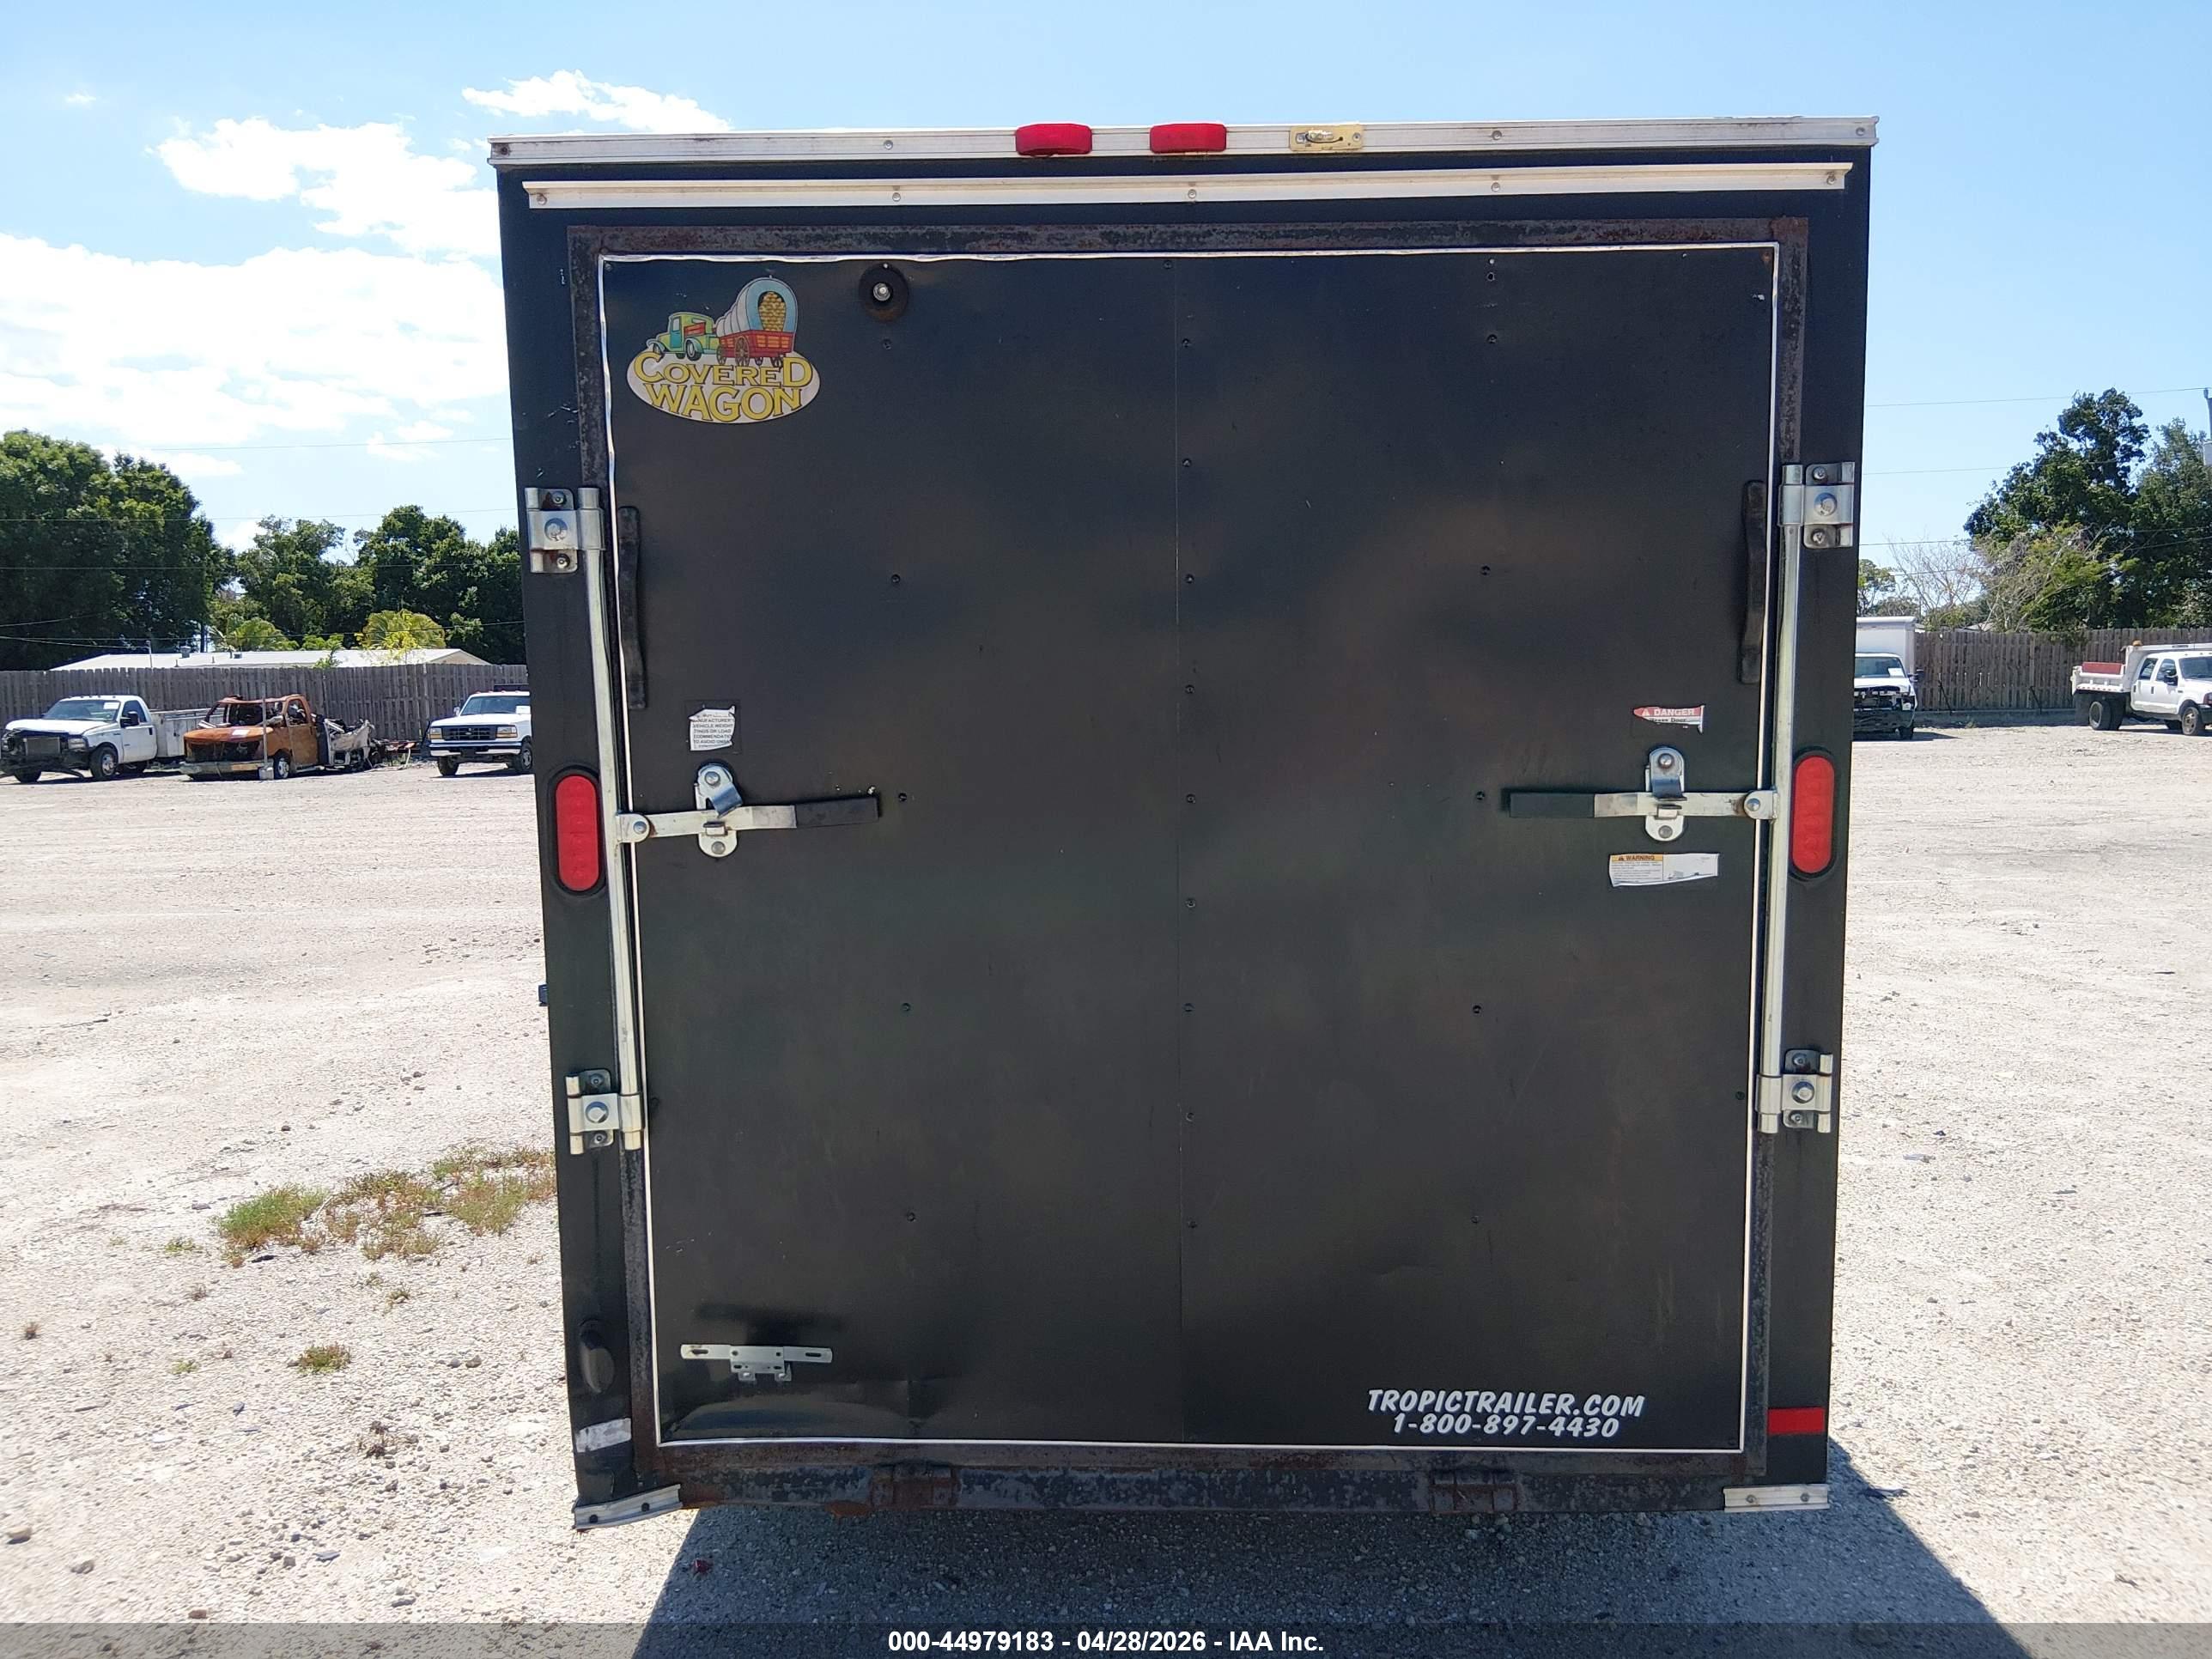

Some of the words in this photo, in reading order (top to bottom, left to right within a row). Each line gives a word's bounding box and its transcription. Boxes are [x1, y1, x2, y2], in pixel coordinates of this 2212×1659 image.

[634, 350, 814, 387] COVERED
[643, 383, 804, 422] WAGON
[1368, 1389, 1645, 1417] TROPICTRAILER.COM
[1394, 1413, 1620, 1437] 1-800-897-4430
